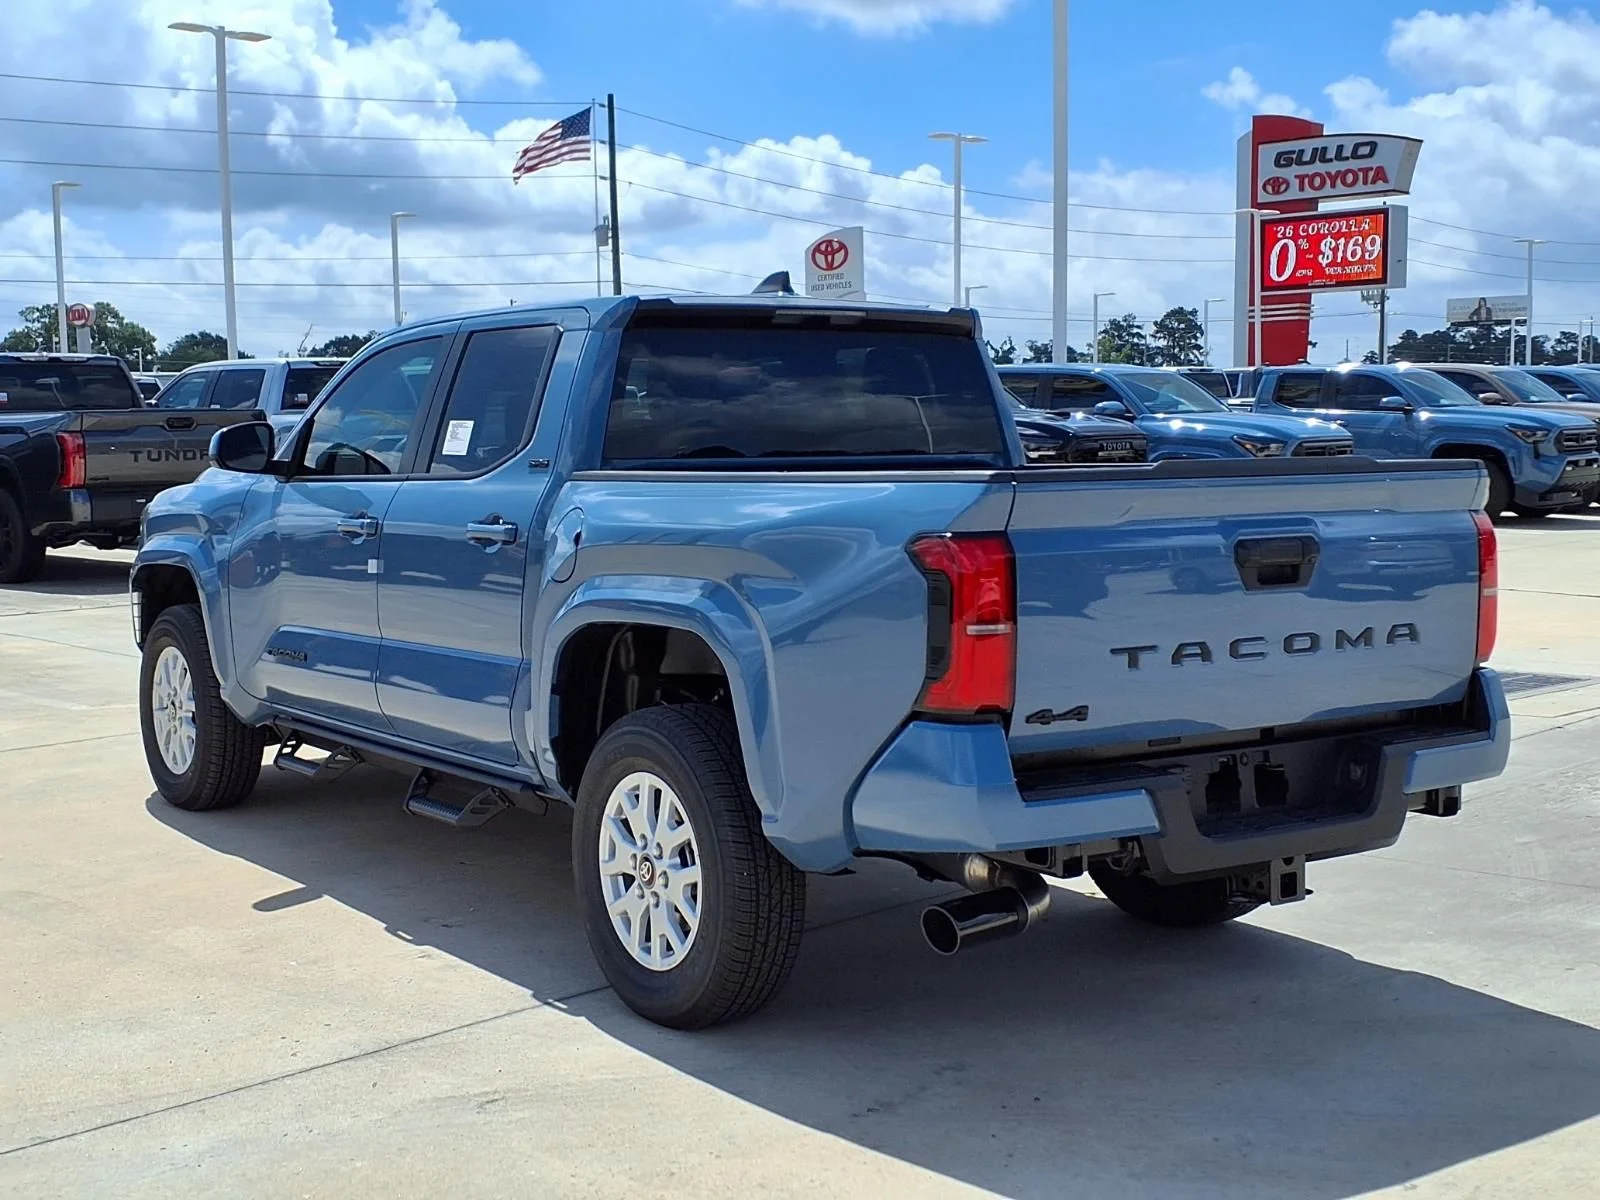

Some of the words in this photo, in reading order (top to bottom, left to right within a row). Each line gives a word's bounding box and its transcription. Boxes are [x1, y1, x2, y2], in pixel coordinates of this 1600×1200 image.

[1274, 140, 1378, 168] GULLO
[1294, 165, 1389, 192] TOYOTA
[1298, 218, 1371, 236] COROLLA
[1318, 234, 1381, 268] $169
[810, 283, 825, 291] USED
[826, 280, 852, 290] VEHICLES
[817, 272, 845, 282] CERTIFIED
[129, 448, 209, 463] TUNDR
[1103, 442, 1131, 451] TOYOTA
[1109, 622, 1421, 670] TACOMA
